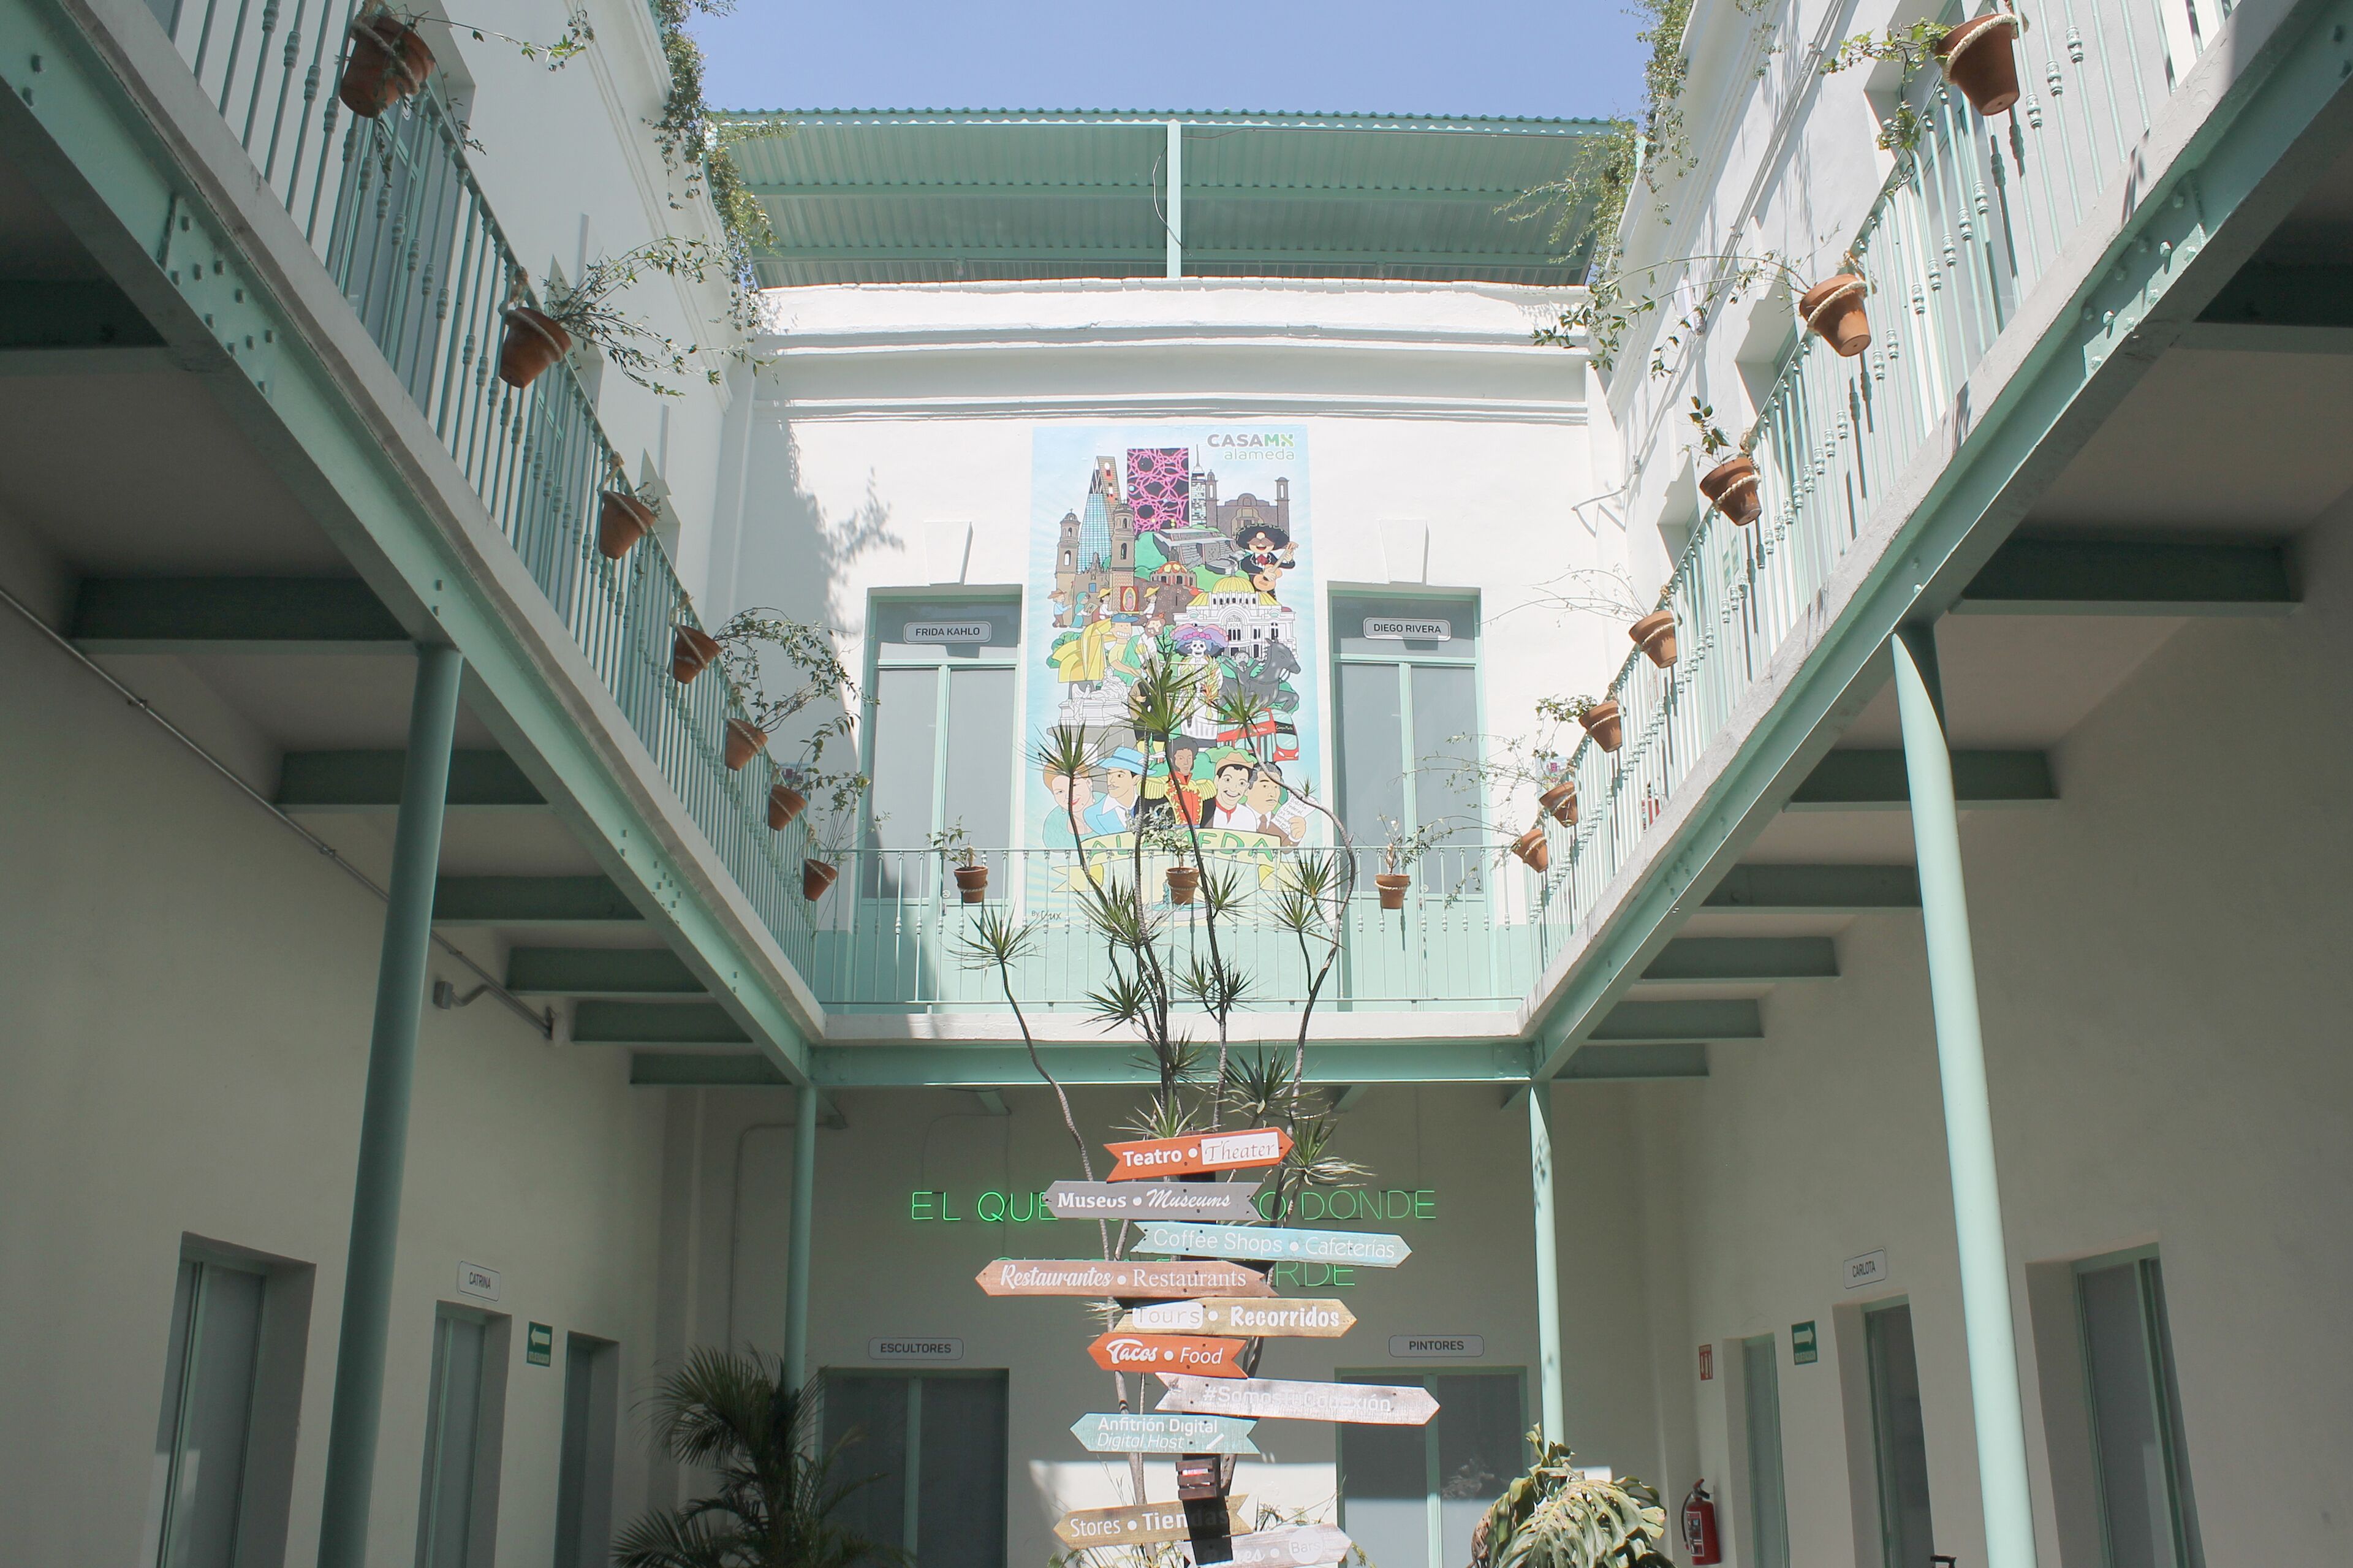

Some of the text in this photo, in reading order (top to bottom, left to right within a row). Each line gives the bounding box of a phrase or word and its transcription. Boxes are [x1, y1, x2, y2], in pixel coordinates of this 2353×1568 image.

[1207, 433, 1294, 447] CASAMX
[1224, 448, 1295, 460] alameda
[1373, 624, 1442, 634] DIEGO RIVERA
[1122, 1140, 1275, 1167] Teatro Theater
[911, 1191, 961, 1221] EL
[977, 1191, 1059, 1222] QUE
[1301, 1190, 1436, 1220] DONDE
[1057, 1192, 1126, 1208] Museos
[1146, 1188, 1231, 1209] Museums
[1154, 1228, 1395, 1259] Coffee Shops Cafeterías
[1000, 1264, 1247, 1289] Restaurantes Restaurants
[1275, 1260, 1356, 1287] RDE
[1852, 1260, 1876, 1278] CARLOTA
[469, 1271, 491, 1289] CATRINA
[1137, 1305, 1340, 1328] Tours Recorridos
[881, 1343, 952, 1353] ESCULTORES
[1105, 1338, 1223, 1365] Tacos Food
[1409, 1341, 1464, 1350] PINTORES
[1097, 1416, 1218, 1436] Anfitrión Digital
[1097, 1433, 1184, 1450] Digital Host
[1069, 1518, 1121, 1537] Stores
[1291, 1540, 1322, 1555] Bars
